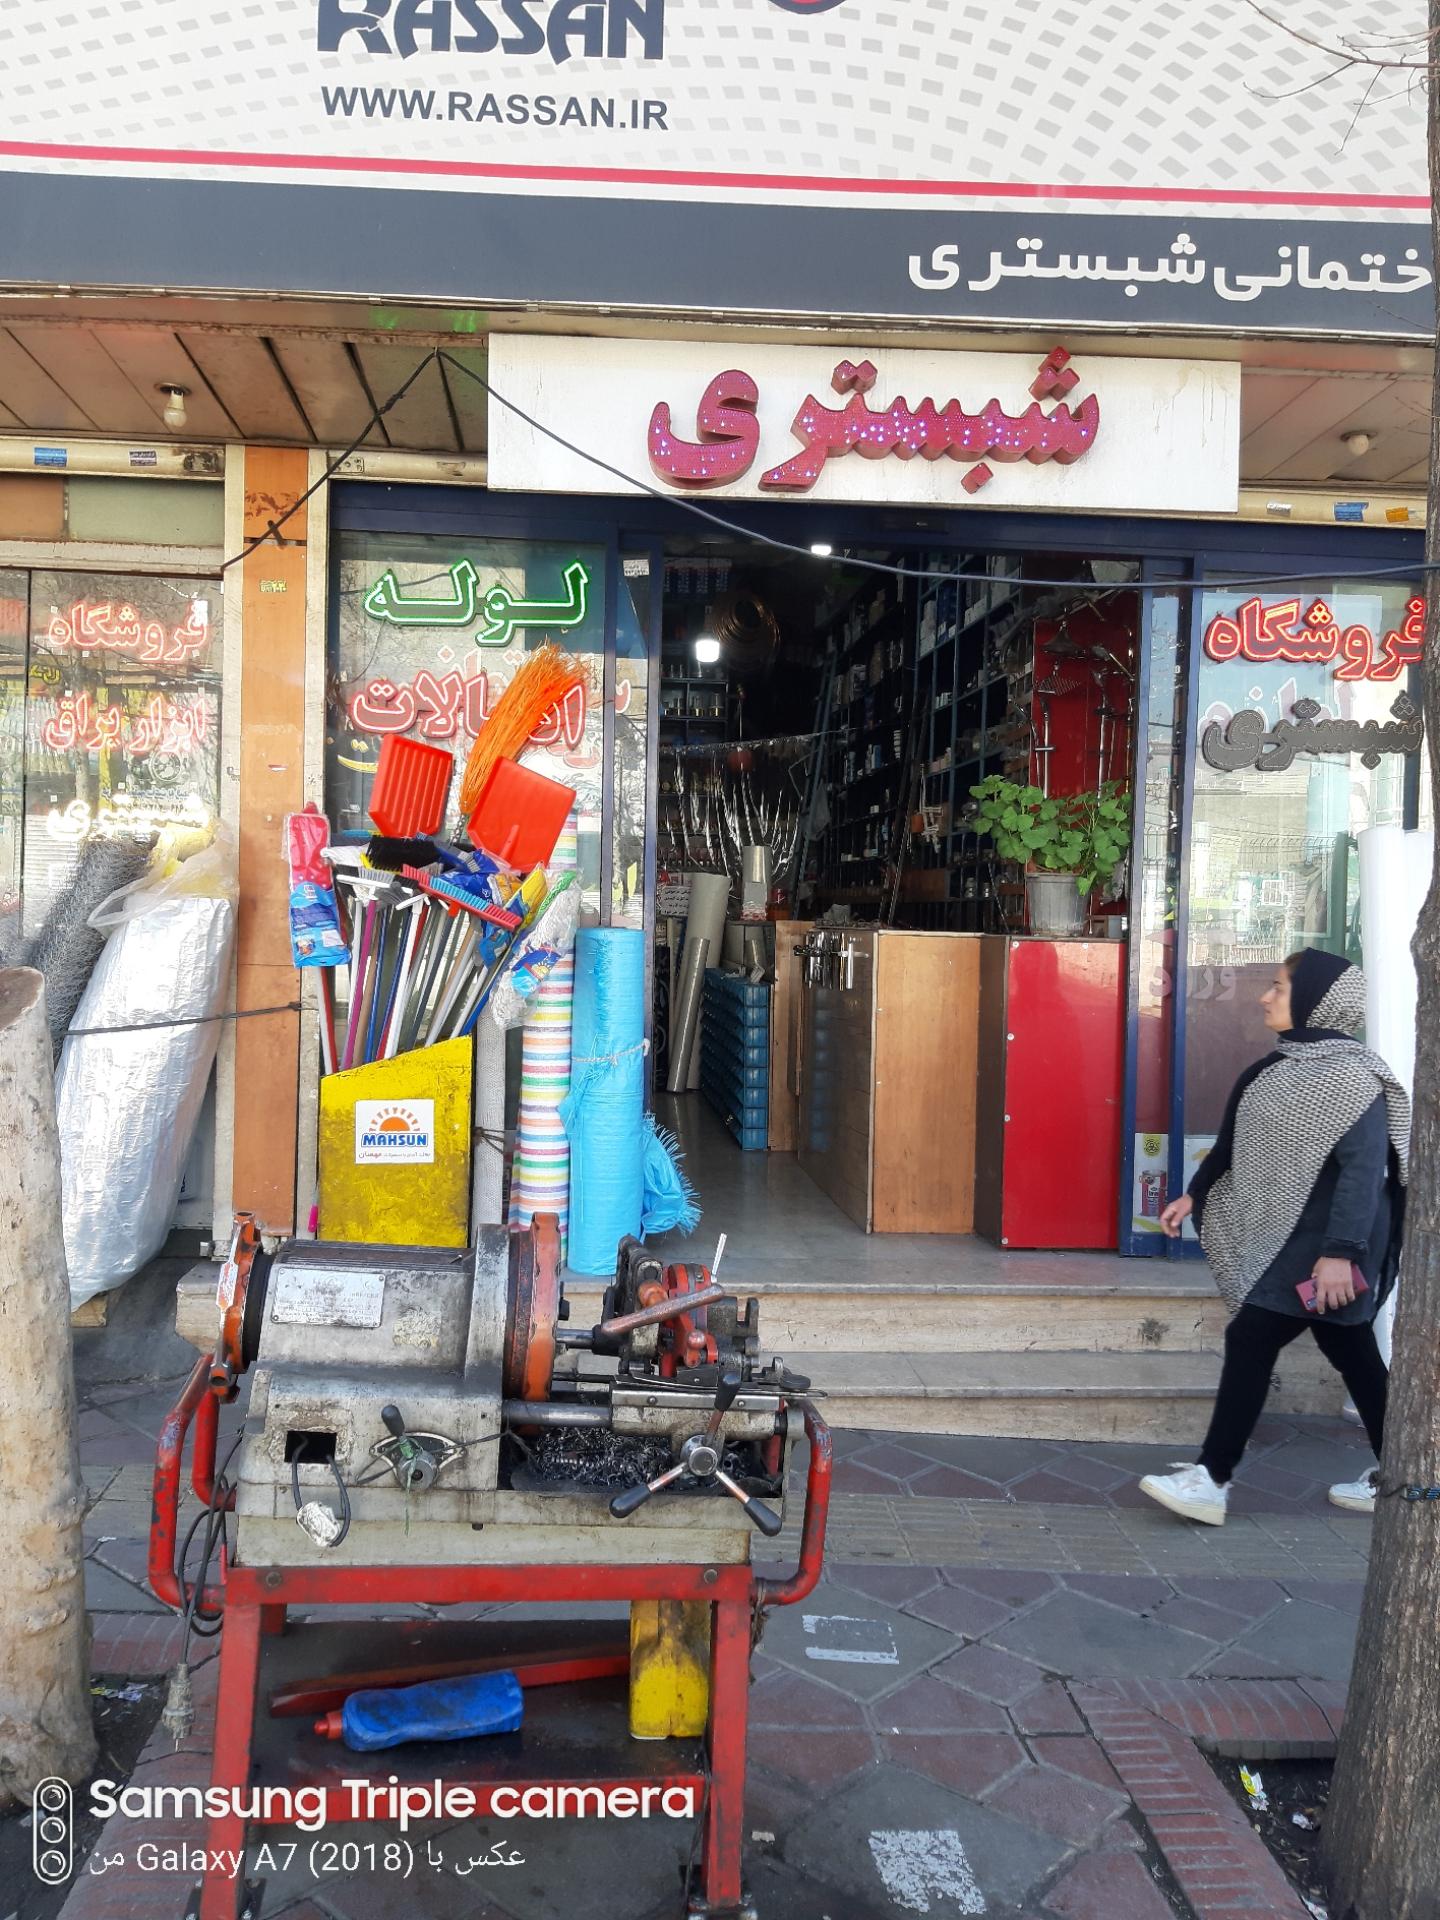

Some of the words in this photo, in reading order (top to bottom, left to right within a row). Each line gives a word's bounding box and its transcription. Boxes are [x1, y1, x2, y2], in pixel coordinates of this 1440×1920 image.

[317, 0, 665, 64] RASSAN
[320, 86, 669, 131] WWW.RASSAN.IR
[908, 233, 1206, 297] شبستری
[647, 346, 1100, 495] شبستری
[48, 601, 208, 661] فروشگاه
[364, 557, 589, 646] لوله
[1204, 595, 1424, 681] فروشگاه
[45, 693, 120, 750] یراق
[1202, 690, 1424, 772] شبستری
[362, 1133, 428, 1147] MAHSUN
